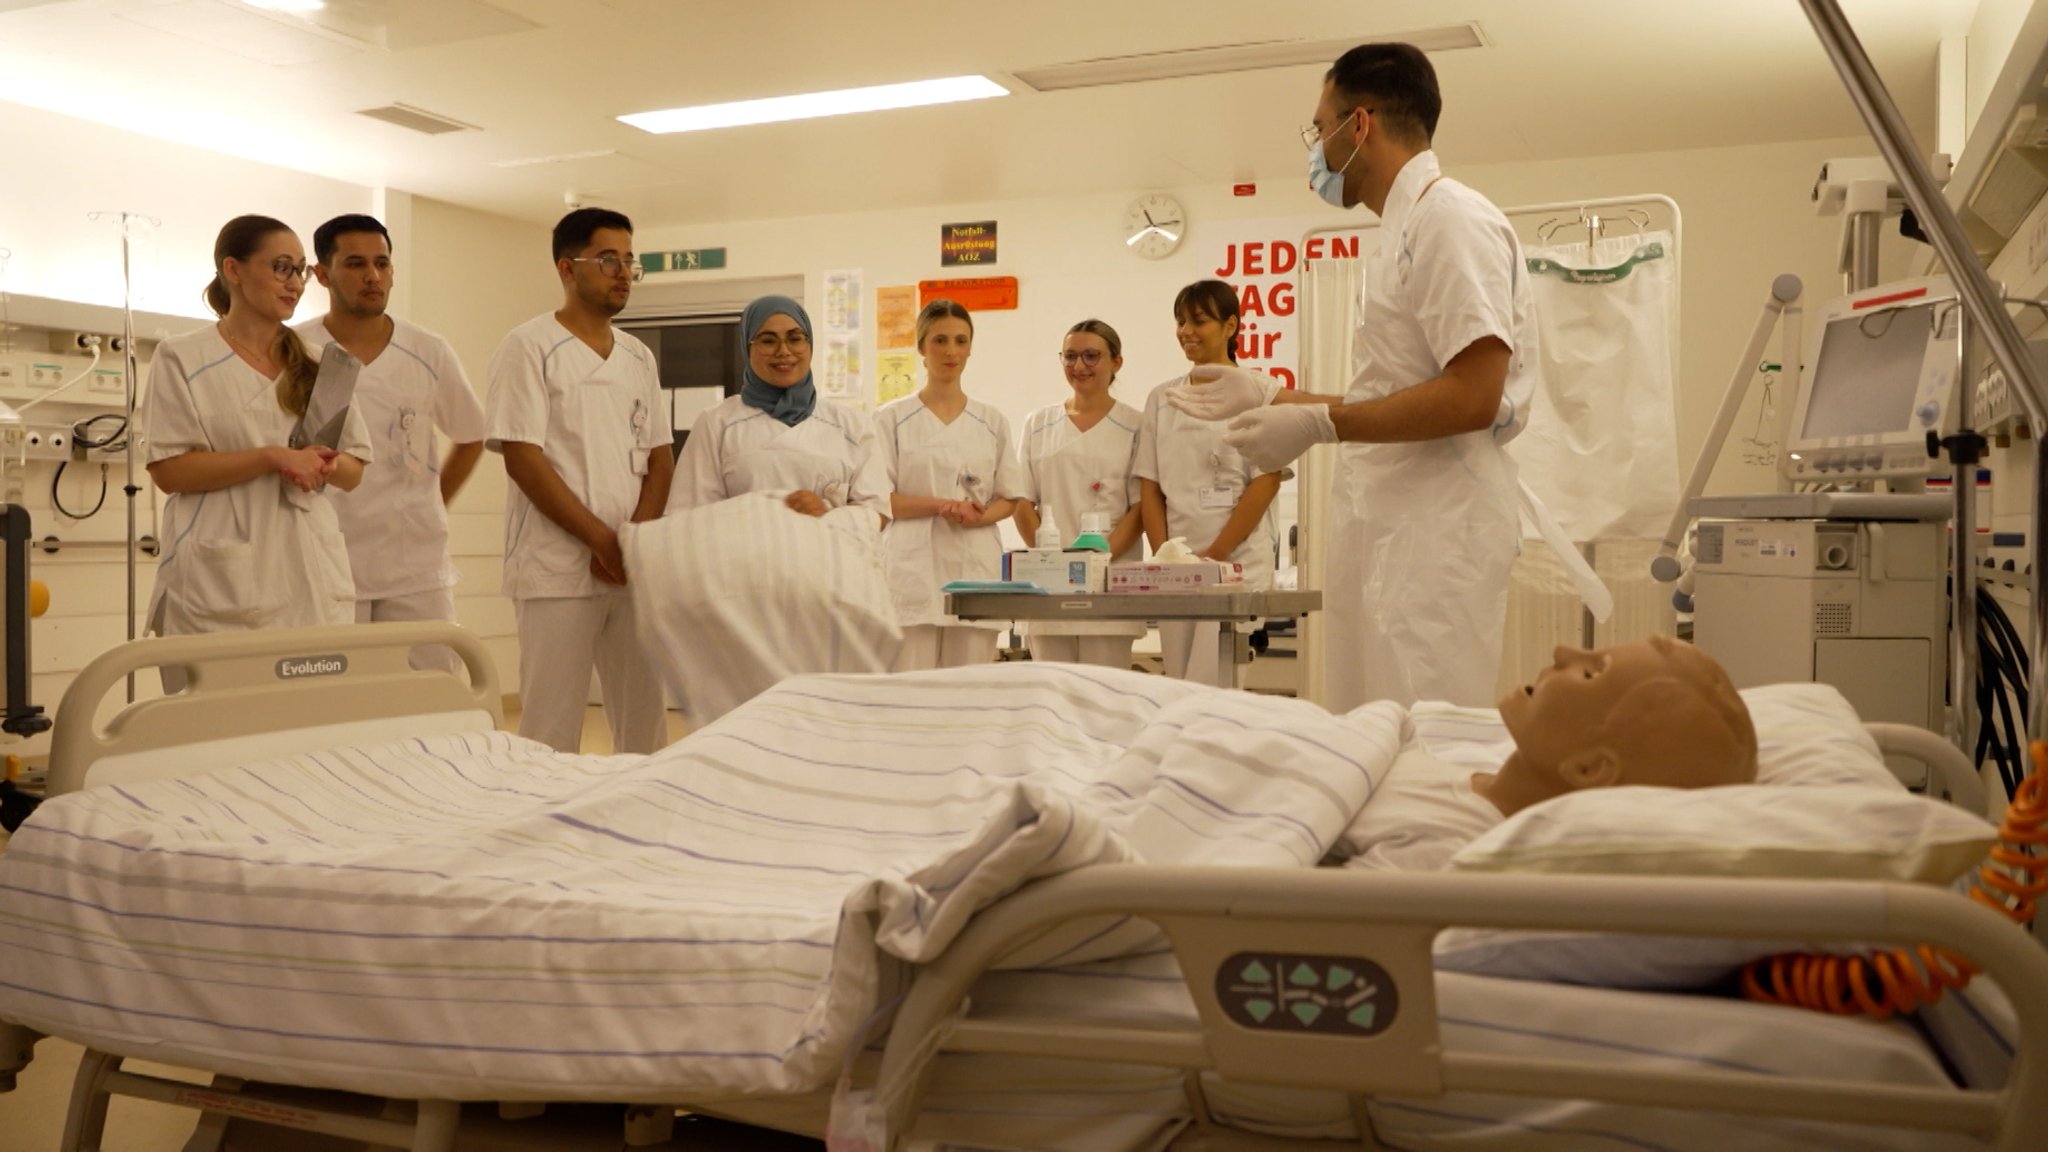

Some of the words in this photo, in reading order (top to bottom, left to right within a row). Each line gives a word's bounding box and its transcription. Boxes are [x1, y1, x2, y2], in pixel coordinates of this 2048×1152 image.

[952, 226, 986, 237] Notfall-
[1232, 283, 1295, 317] AG
[1236, 322, 1282, 359] ür
[281, 659, 342, 676] Evolution
